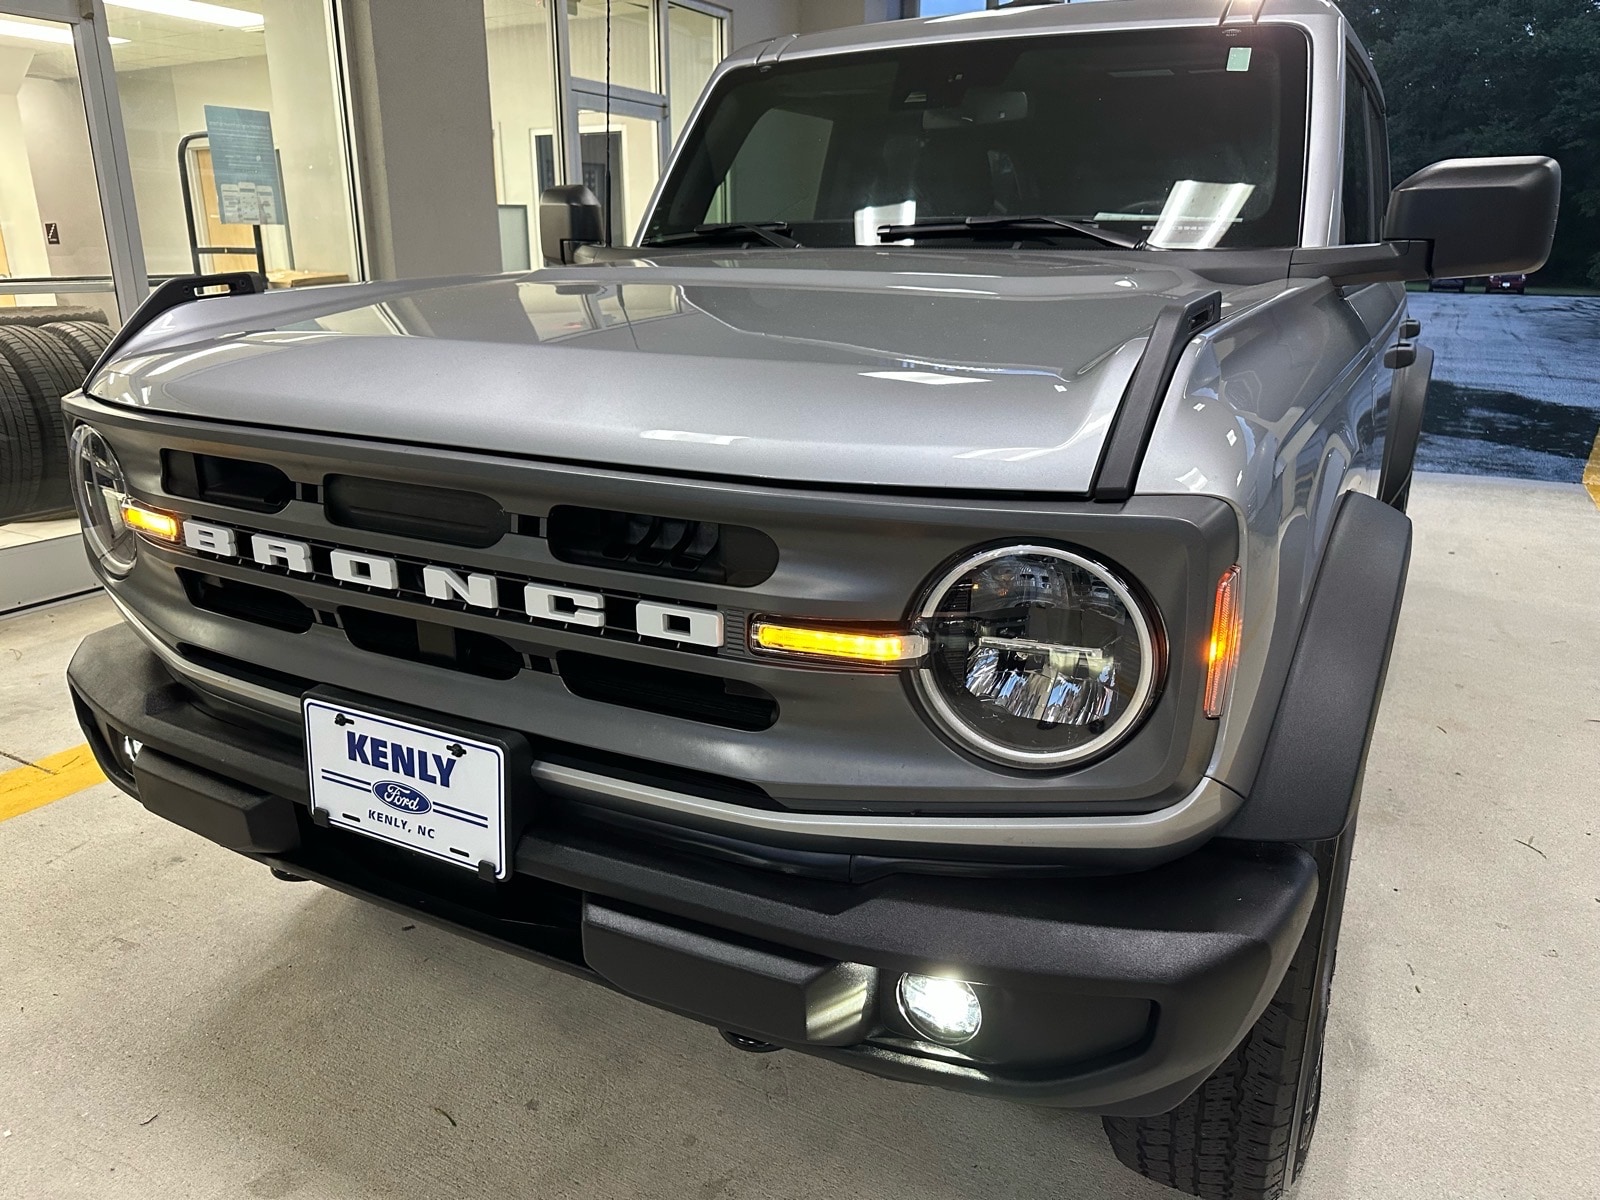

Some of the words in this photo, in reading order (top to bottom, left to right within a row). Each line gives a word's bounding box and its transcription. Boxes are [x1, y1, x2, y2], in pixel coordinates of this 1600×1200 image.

[182, 518, 724, 647] BRONCO
[346, 730, 457, 788] KENLY
[384, 784, 420, 811] Ford
[368, 809, 412, 833] KENLY,
[417, 824, 436, 839] NC
